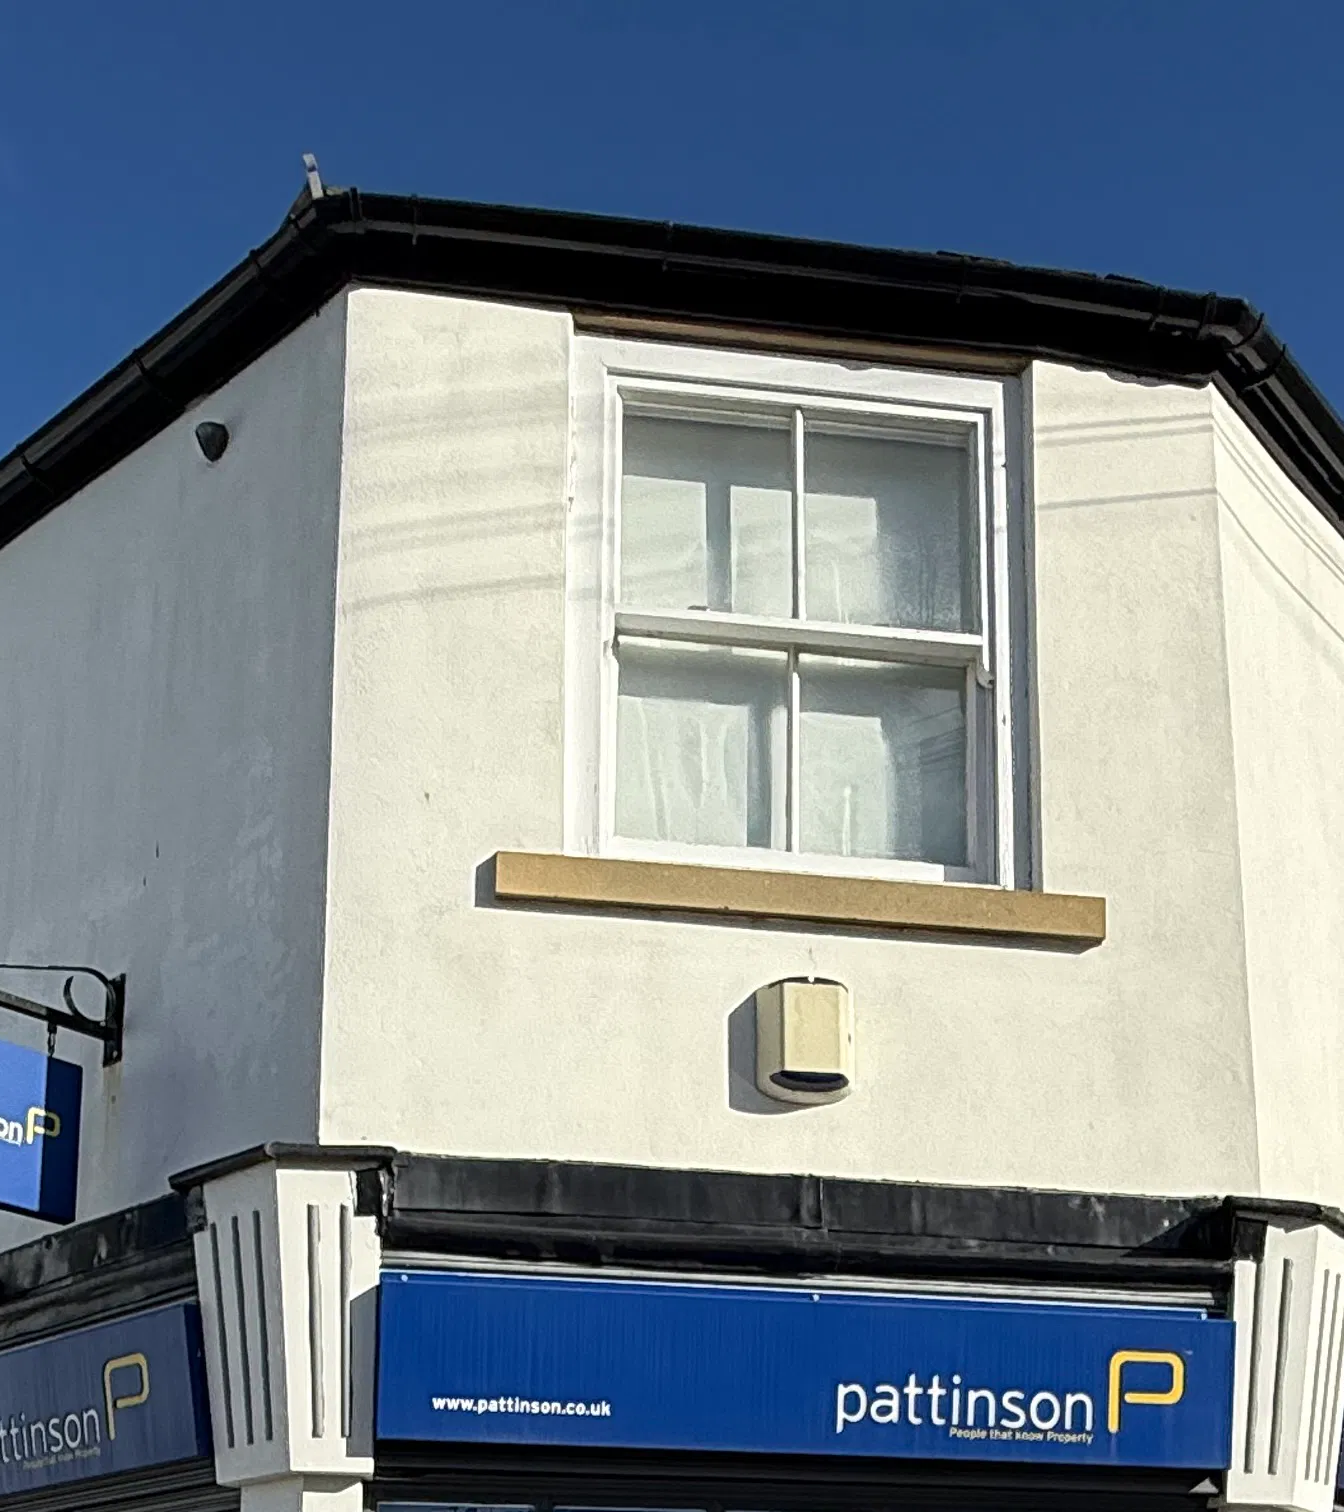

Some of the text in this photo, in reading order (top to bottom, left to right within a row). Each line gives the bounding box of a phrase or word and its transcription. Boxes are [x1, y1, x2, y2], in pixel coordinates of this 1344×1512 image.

[432, 1396, 611, 1417] www.pattinson.co.uk
[836, 1373, 1093, 1434] pattinson
[949, 1427, 986, 1441] People
[990, 1429, 1012, 1440] that
